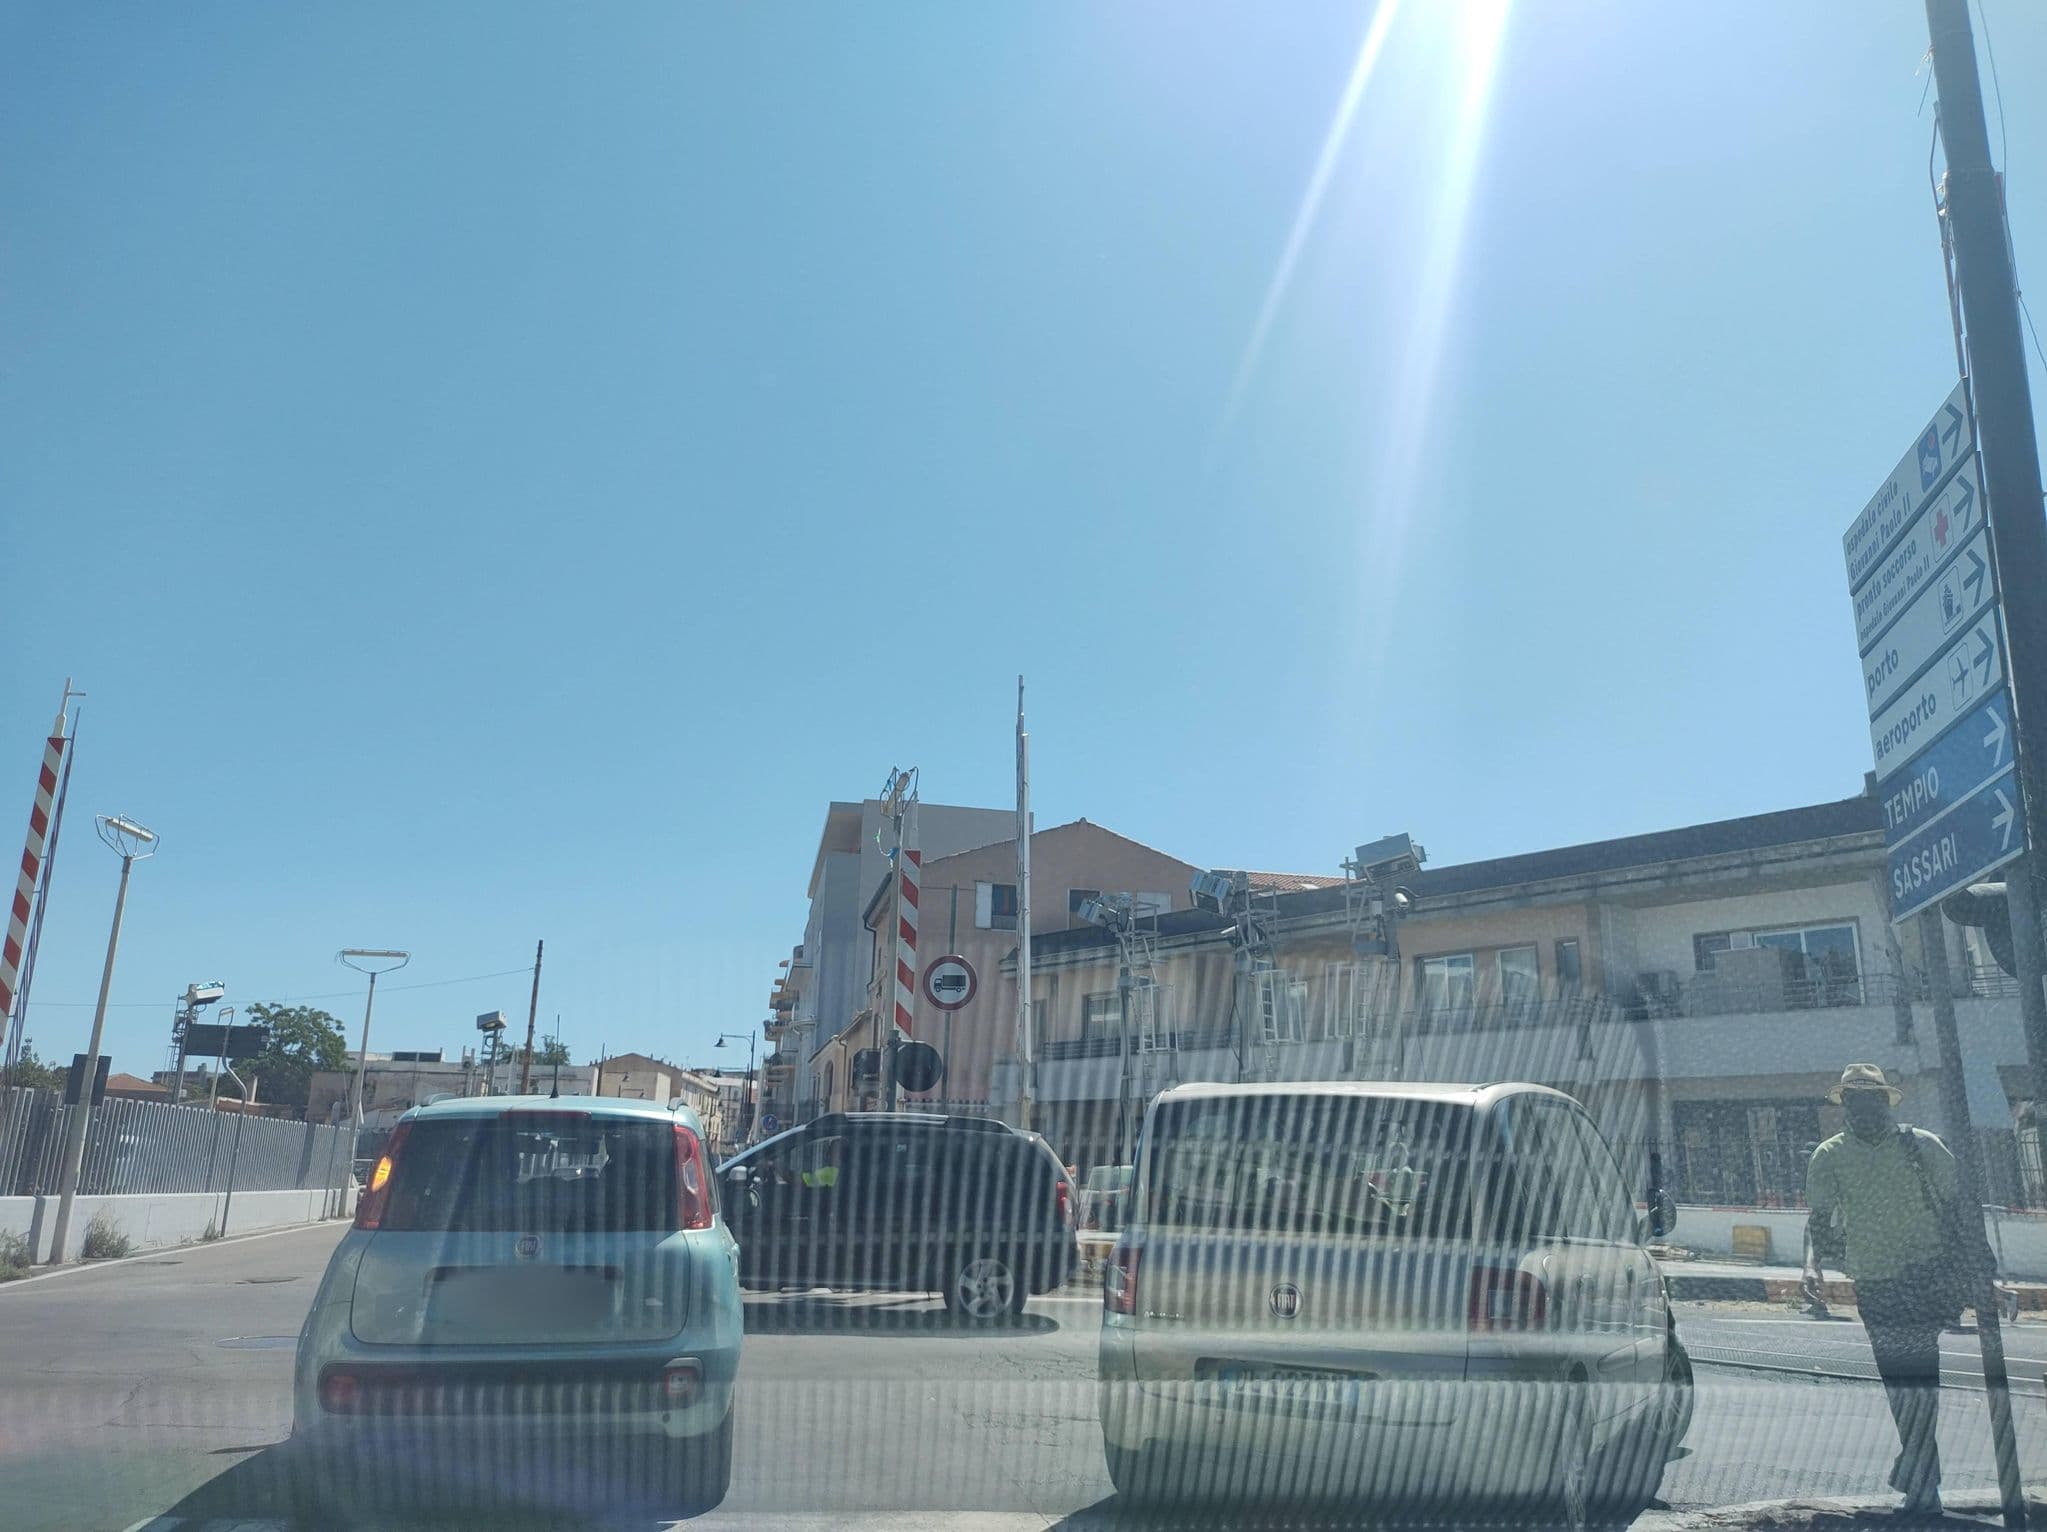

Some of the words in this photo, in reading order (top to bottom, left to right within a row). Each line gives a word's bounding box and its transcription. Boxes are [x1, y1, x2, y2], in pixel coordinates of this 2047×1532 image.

[1877, 480, 1898, 517] civile
[1850, 531, 1880, 581] Giovanni
[1880, 508, 1902, 544] Paolo
[1857, 579, 1881, 622] pronto
[1883, 539, 1917, 589] soccorso
[1867, 648, 1900, 699] porto
[1875, 693, 1937, 761] aeroporto
[1884, 766, 1941, 830] TEMPIO
[1893, 832, 1960, 900] SASSARI
[1277, 1293, 1297, 1310] FIAT
